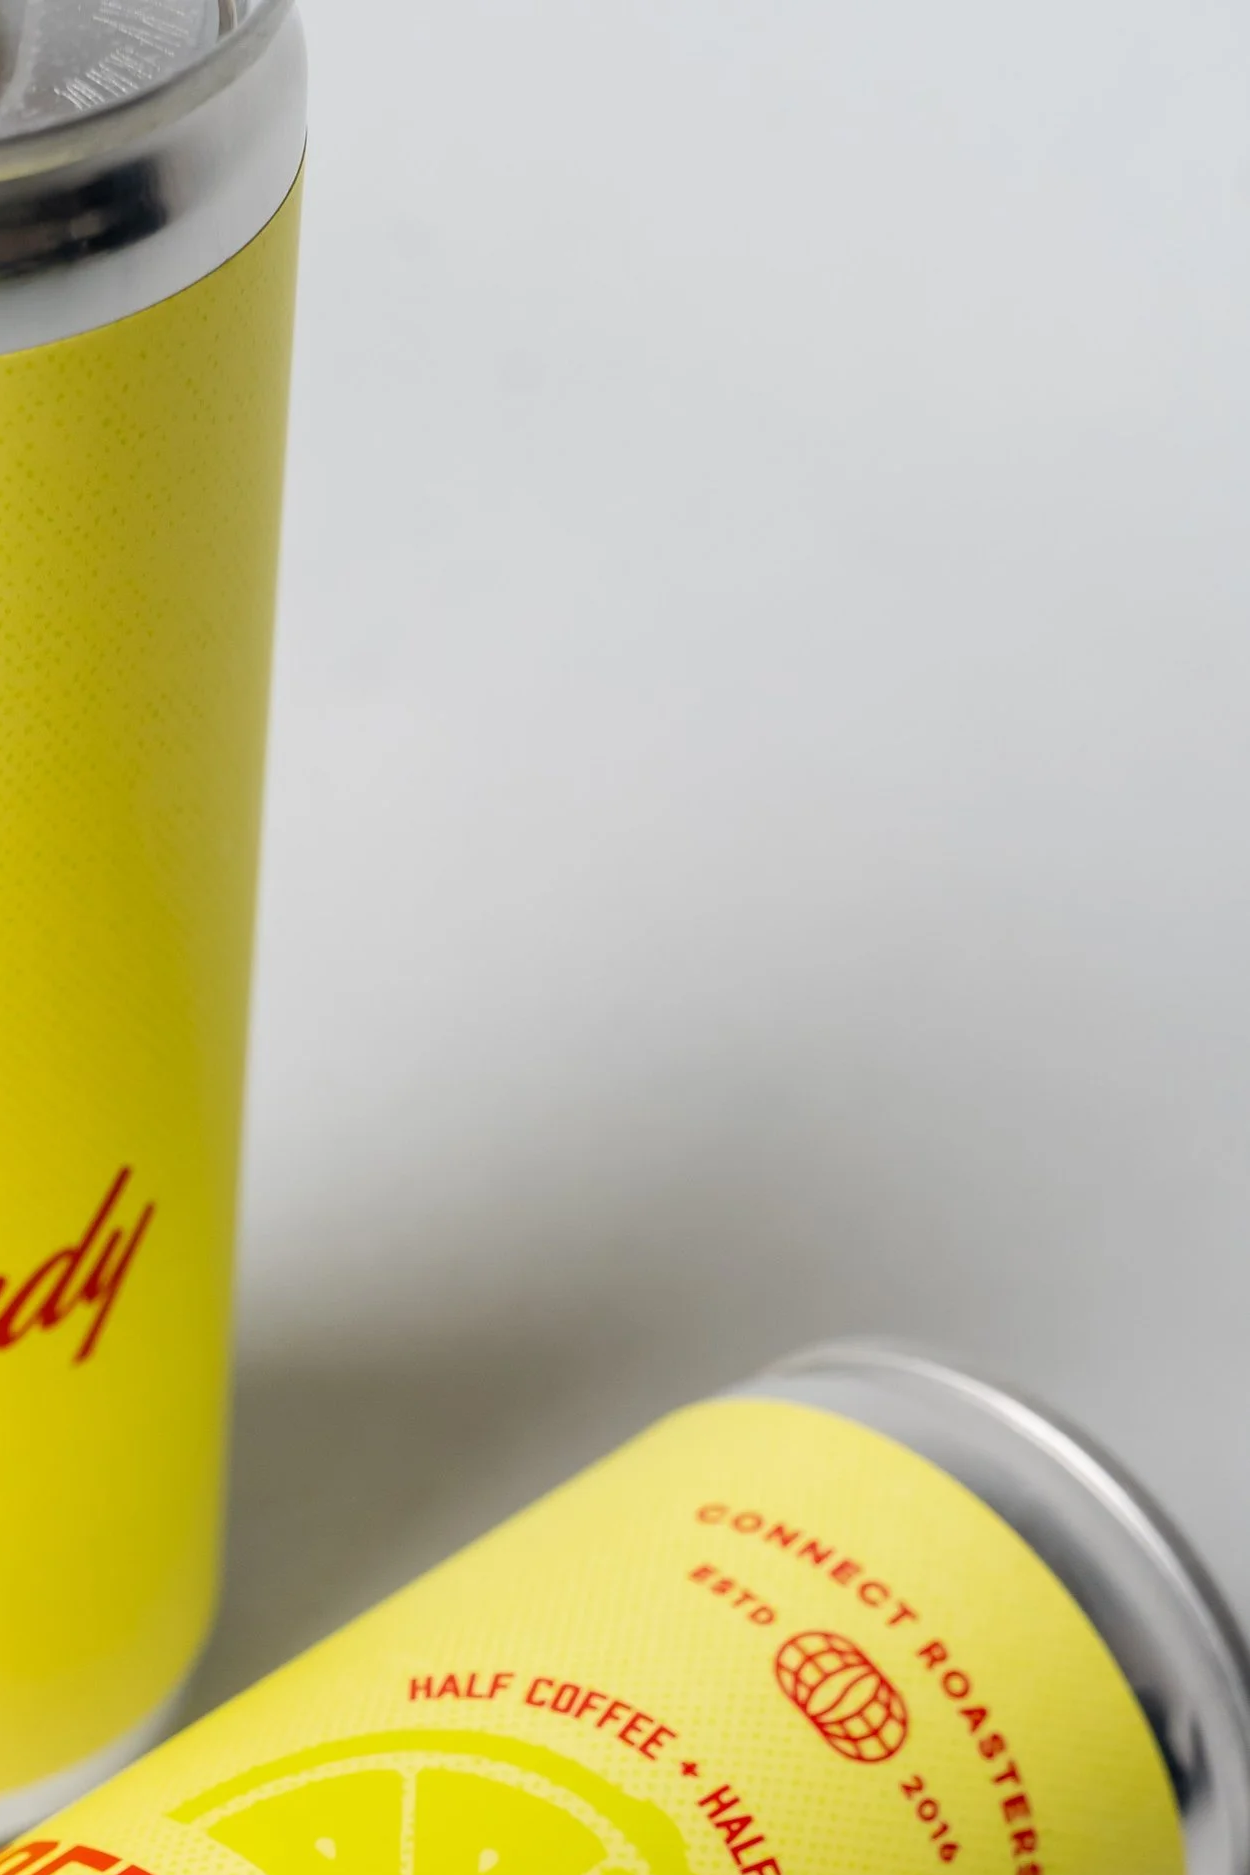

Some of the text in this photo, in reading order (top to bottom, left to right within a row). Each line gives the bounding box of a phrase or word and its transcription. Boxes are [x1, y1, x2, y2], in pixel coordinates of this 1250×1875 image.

[694, 1502, 919, 1629] CONNECT
[407, 1671, 516, 1704] HALF
[522, 1675, 678, 1762] COFFEE
[687, 1562, 961, 1865] ESTD 2016
